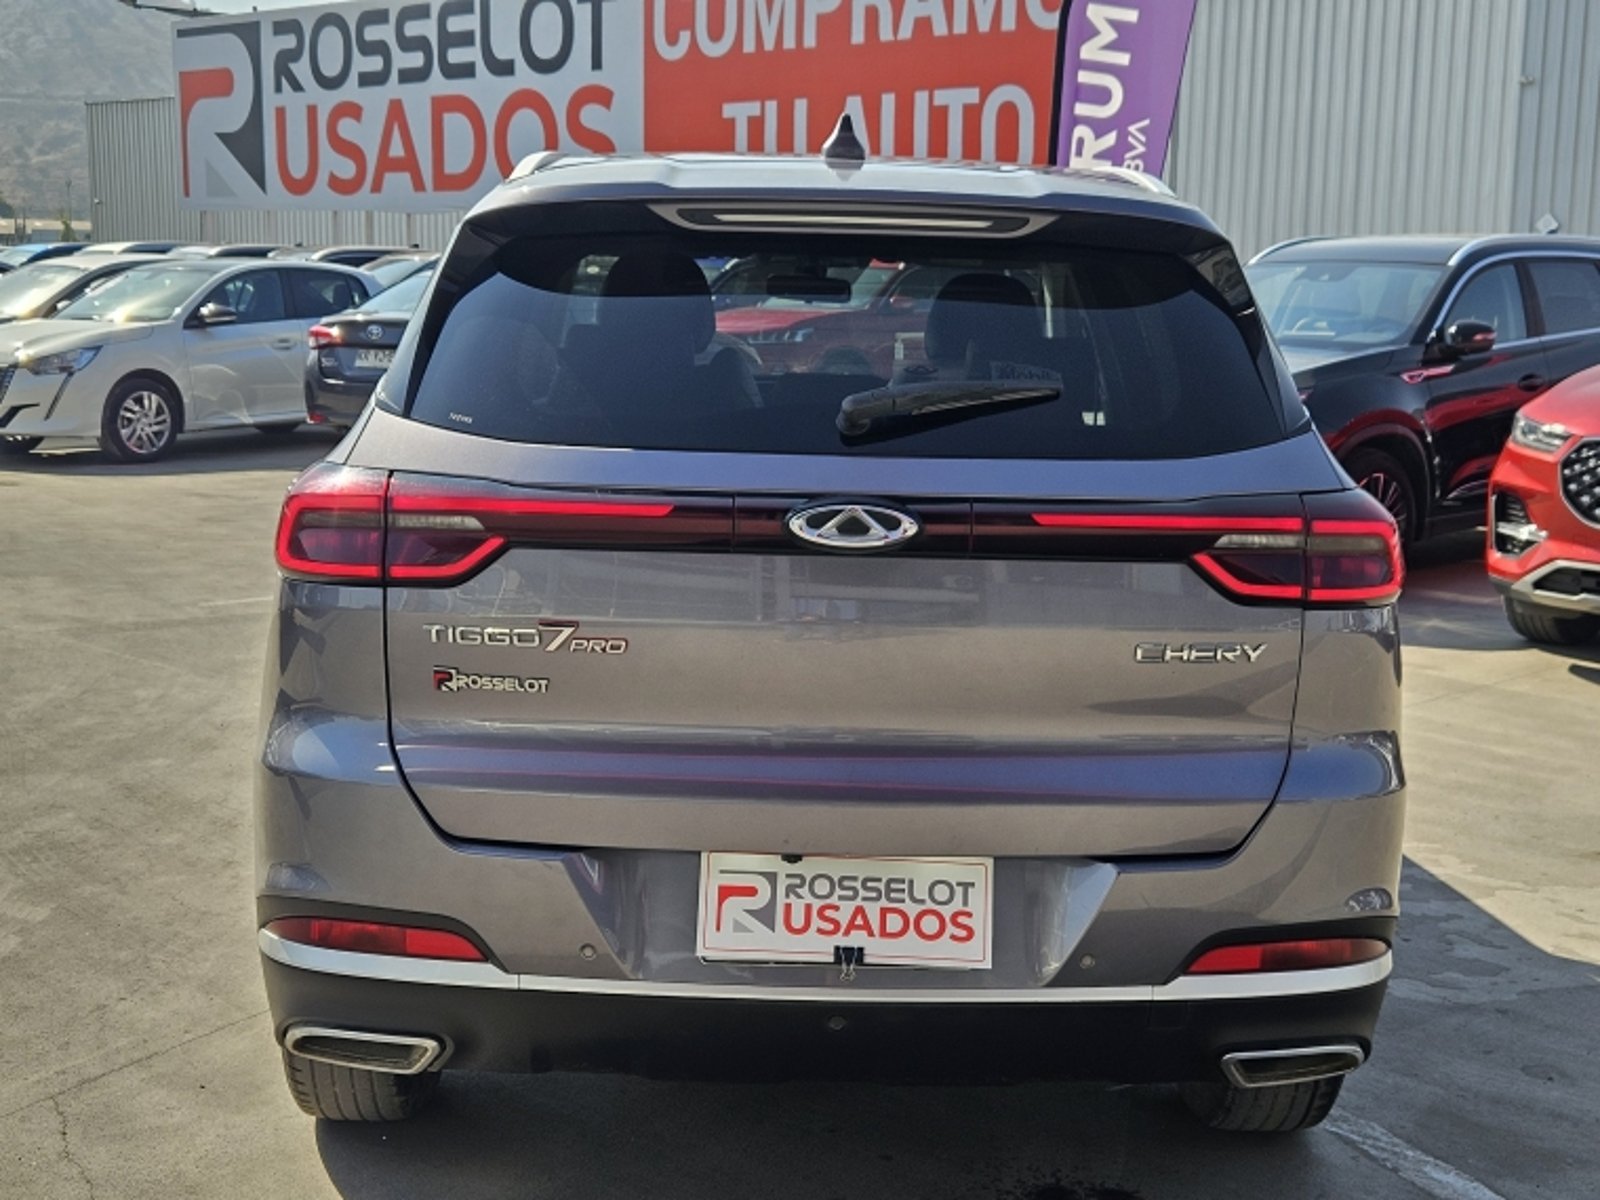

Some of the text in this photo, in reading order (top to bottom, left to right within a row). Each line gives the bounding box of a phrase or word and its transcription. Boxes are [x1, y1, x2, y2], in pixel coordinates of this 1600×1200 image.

[273, 0, 617, 93] ROSSELOT
[275, 84, 616, 197] USADOS
[838, 83, 1035, 166] AUTO
[1134, 640, 1268, 663] CHERY
[784, 873, 975, 907] ROSSELOT
[783, 903, 975, 943] USADOS
